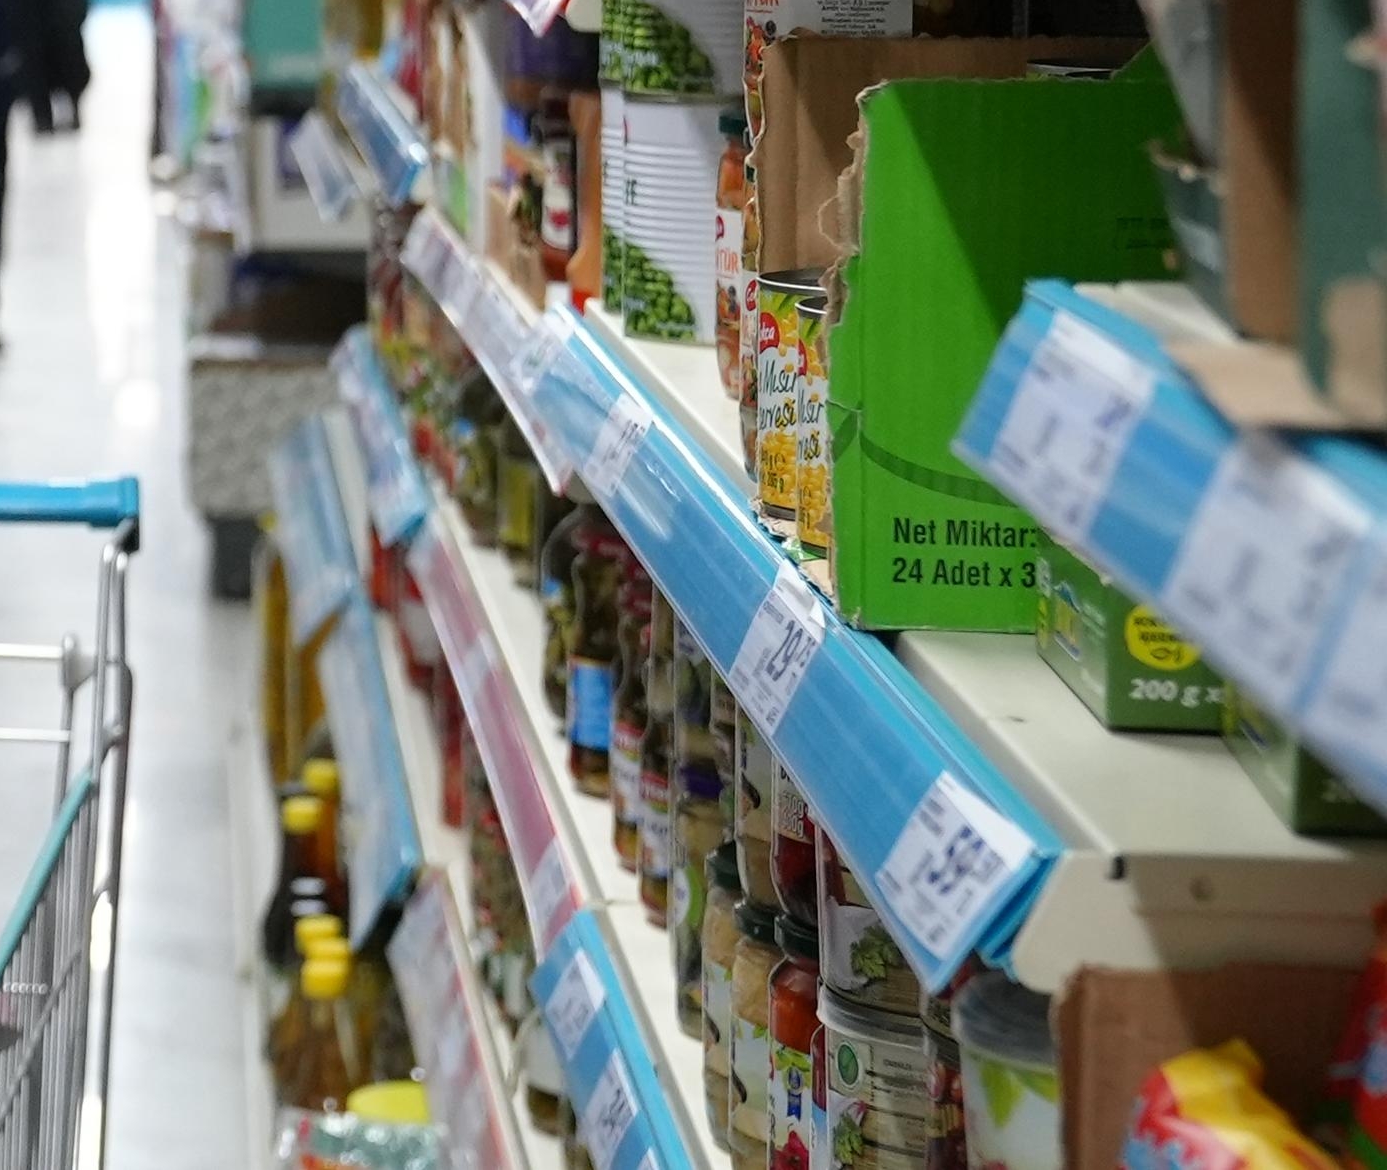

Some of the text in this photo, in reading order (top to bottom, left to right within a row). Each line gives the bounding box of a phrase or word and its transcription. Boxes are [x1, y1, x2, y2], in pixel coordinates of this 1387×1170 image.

[893, 517, 1037, 548] Net Miktar:
[892, 557, 923, 583] 24
[932, 559, 991, 587] Adet
[999, 567, 1013, 587] x
[1128, 678, 1178, 702] 200
[1180, 686, 1201, 708] g
